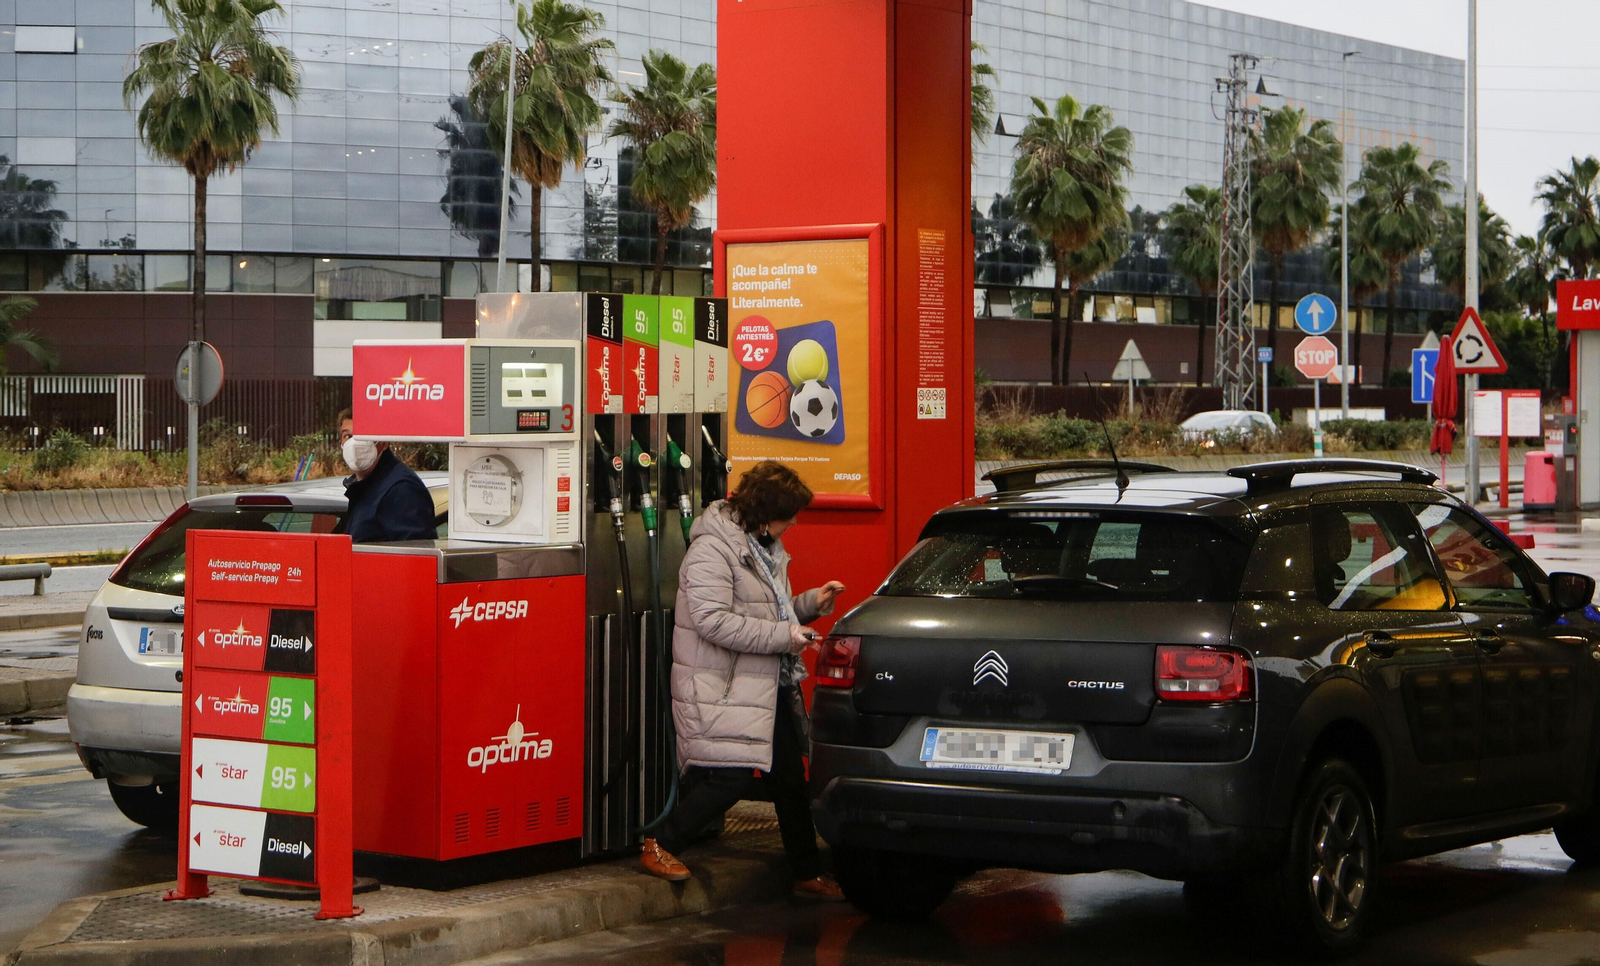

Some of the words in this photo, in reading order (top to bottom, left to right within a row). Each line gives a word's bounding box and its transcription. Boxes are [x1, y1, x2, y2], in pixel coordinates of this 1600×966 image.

[733, 264, 756, 279] ¡Que
[759, 264, 769, 275] la
[771, 264, 804, 275] calma
[807, 263, 817, 274] te
[732, 277, 791, 292] acompañe!
[732, 296, 803, 309] Literalmente.
[602, 297, 610, 337] Diesel
[635, 310, 646, 334] 95
[672, 308, 683, 333] 95
[736, 332, 774, 341] ANTIESTRÉS
[1298, 350, 1335, 365] STOP
[602, 346, 611, 401] optima
[638, 347, 647, 401] optima
[366, 380, 444, 406] optima
[561, 404, 574, 431] 3
[208, 559, 250, 570] Autoservicio
[252, 560, 281, 572] Prepago
[287, 567, 302, 577] 24h
[211, 571, 253, 582] Self-service
[254, 573, 279, 584] Prepay
[474, 600, 528, 621] CEPSA
[214, 632, 262, 648] optima
[270, 635, 303, 650] Diesel
[1068, 681, 1124, 689] CACTUS
[214, 698, 259, 715] optima
[270, 697, 292, 718] 95
[467, 739, 552, 773] optima
[221, 765, 248, 780] star
[271, 766, 296, 790] 95
[219, 833, 246, 847] star
[268, 838, 302, 855] Diesel
